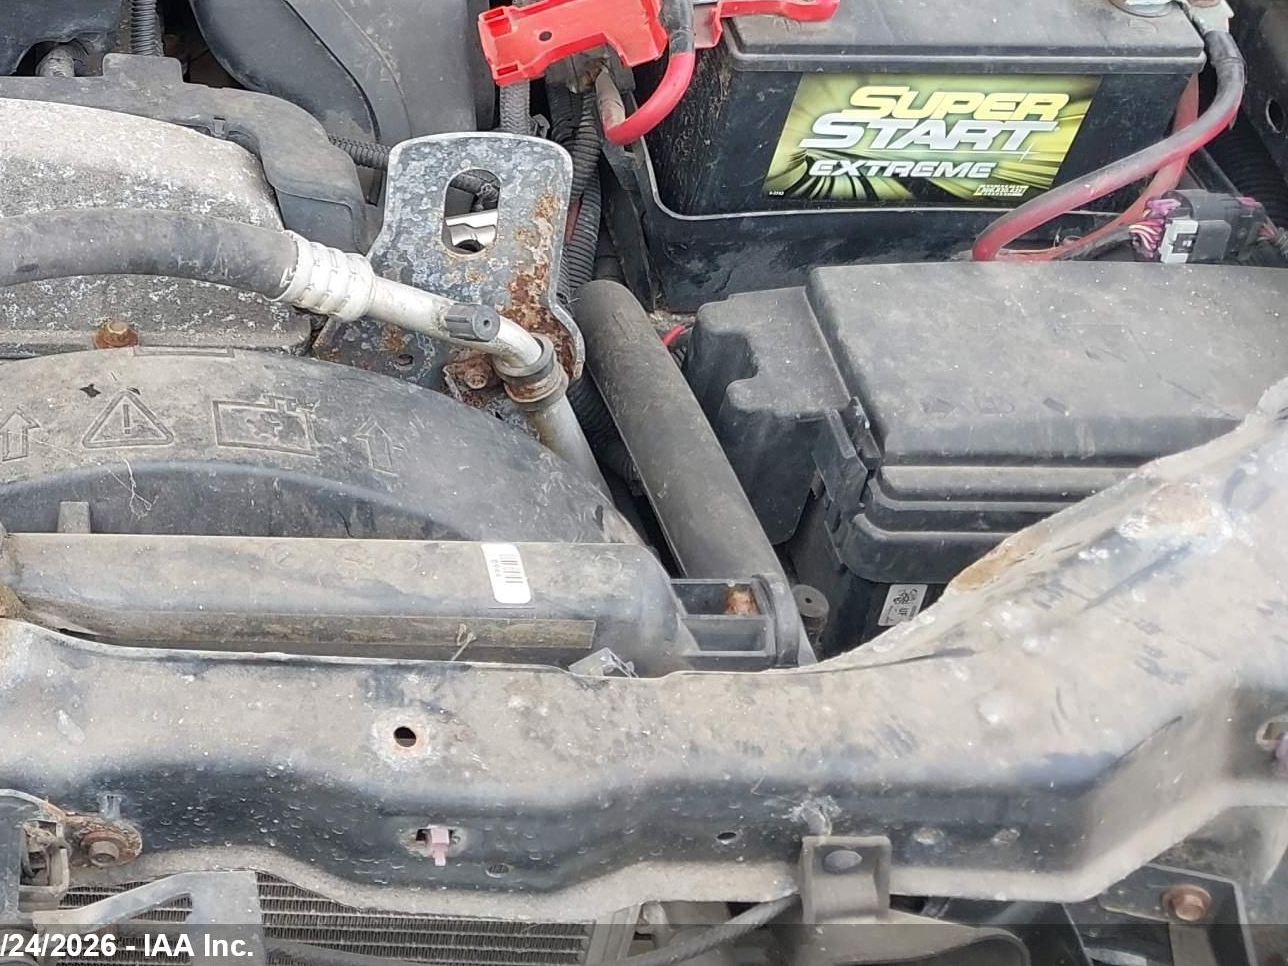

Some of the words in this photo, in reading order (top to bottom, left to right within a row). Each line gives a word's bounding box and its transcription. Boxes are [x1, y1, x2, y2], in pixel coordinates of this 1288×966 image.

[839, 86, 1070, 121] SUPER
[800, 112, 1060, 151] START
[809, 159, 997, 179] EXTREME
